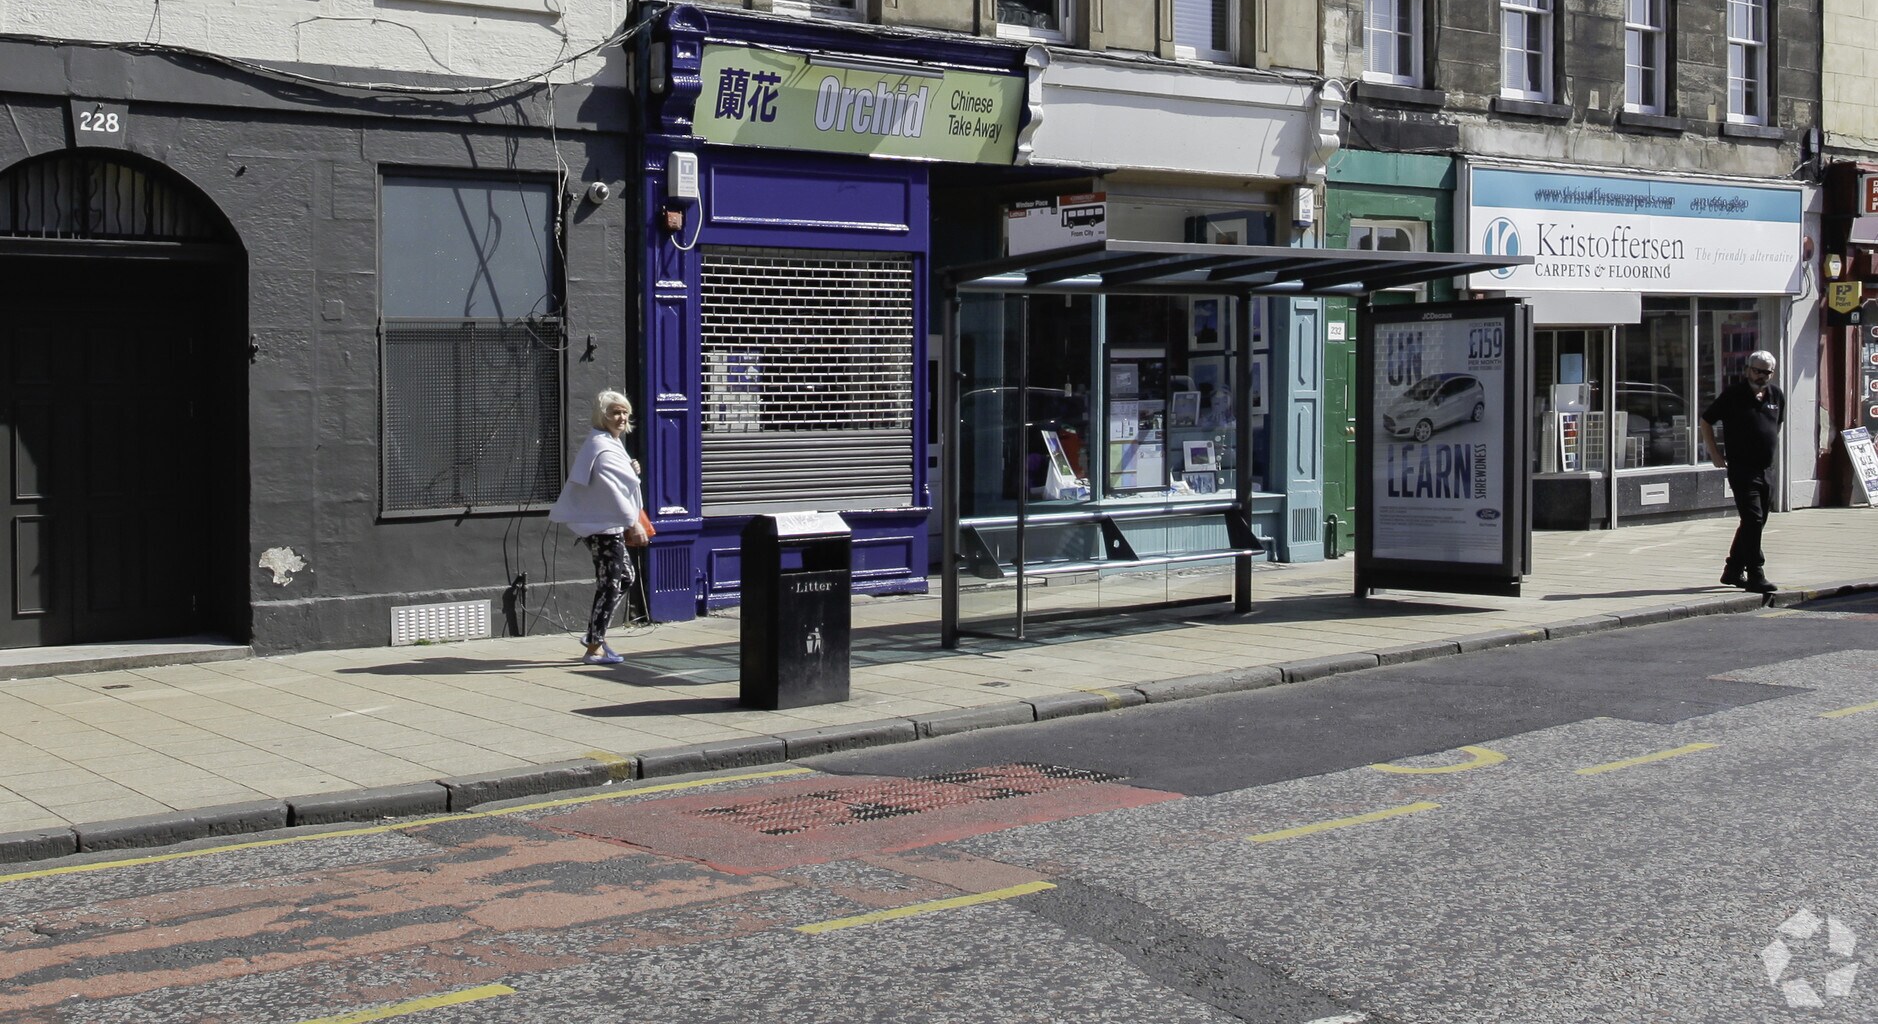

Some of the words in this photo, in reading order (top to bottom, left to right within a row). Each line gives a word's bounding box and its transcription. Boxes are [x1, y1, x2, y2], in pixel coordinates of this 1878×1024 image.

[714, 67, 782, 123] 蘭花
[813, 75, 928, 139] Orchid
[950, 89, 994, 114] Chinese
[80, 111, 120, 133] 228
[948, 114, 972, 138] Take
[973, 117, 1002, 144] Away
[1015, 201, 1035, 209] Windsor
[1035, 199, 1049, 208] Place
[1083, 229, 1094, 237] City
[1536, 222, 1686, 261] Kristoffersen
[1694, 247, 1711, 261] The
[1712, 247, 1747, 265] friendly
[1749, 249, 1794, 263] alternative
[1534, 262, 1591, 278] CARPETS
[1593, 263, 1606, 278] &
[1608, 263, 1672, 279] FLOORING
[1421, 312, 1453, 321] JCDecaux
[1330, 326, 1342, 336] 232
[1468, 327, 1503, 359] £159
[1387, 331, 1423, 387] UN
[1387, 443, 1472, 500] LEARN
[1474, 443, 1487, 500] SHREWDNESS
[795, 581, 832, 593] Litter
